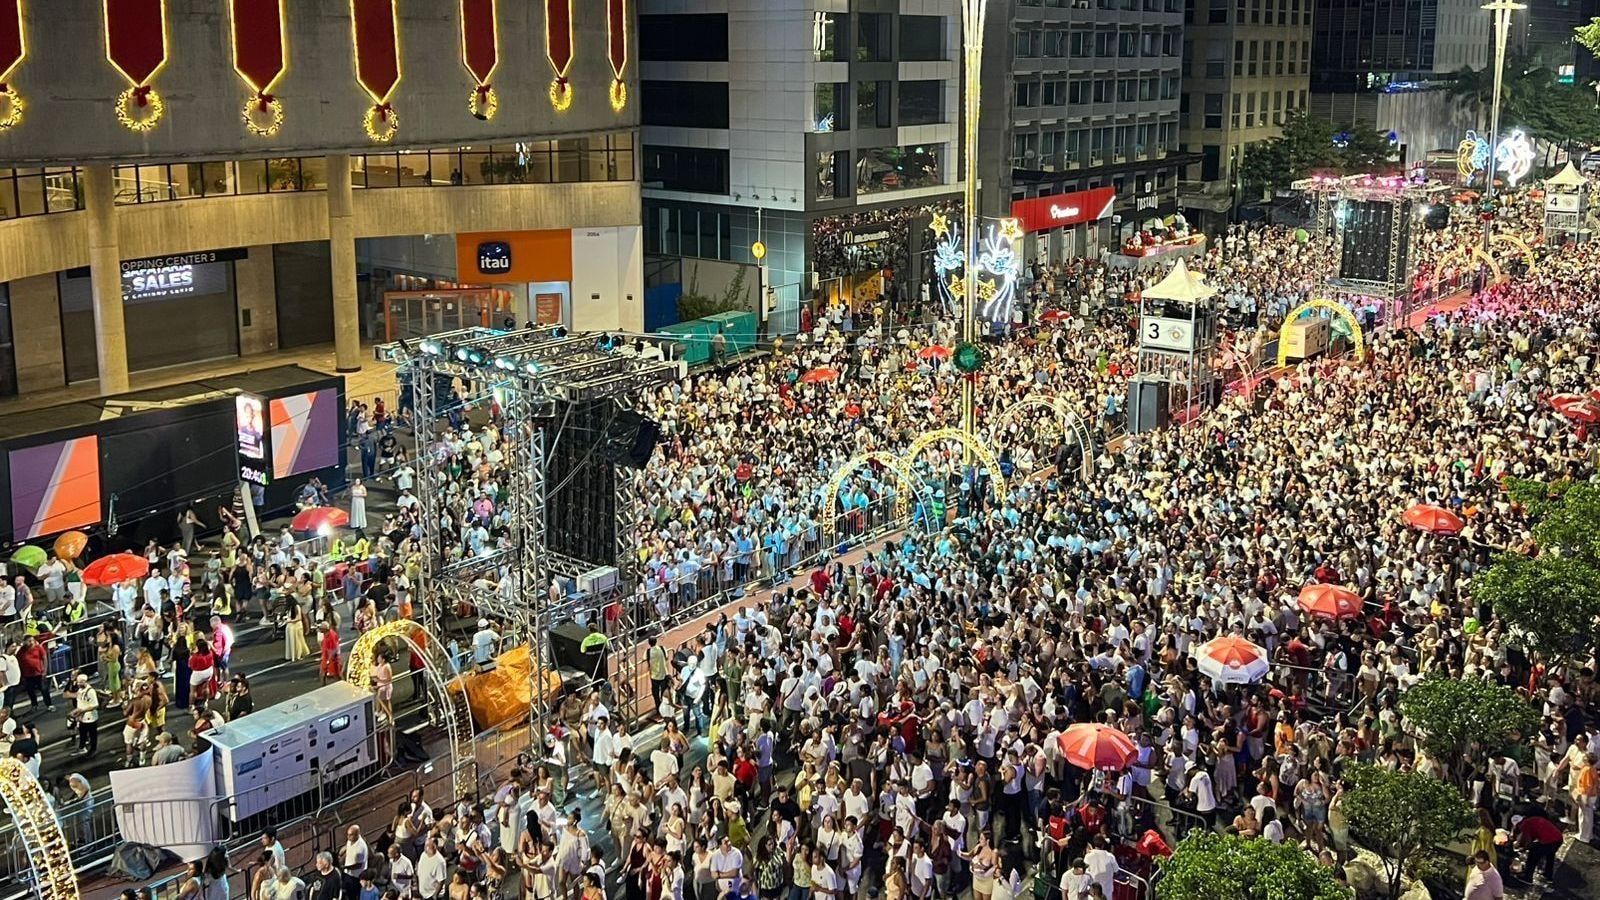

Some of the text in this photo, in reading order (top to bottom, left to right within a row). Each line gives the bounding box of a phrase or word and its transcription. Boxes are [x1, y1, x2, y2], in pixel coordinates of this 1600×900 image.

[1550, 197, 1558, 206] 4
[165, 253, 208, 266] CENTER
[210, 253, 216, 261] 3
[480, 255, 509, 269] itaú
[132, 271, 193, 292] SALES
[1148, 322, 1160, 339] 3
